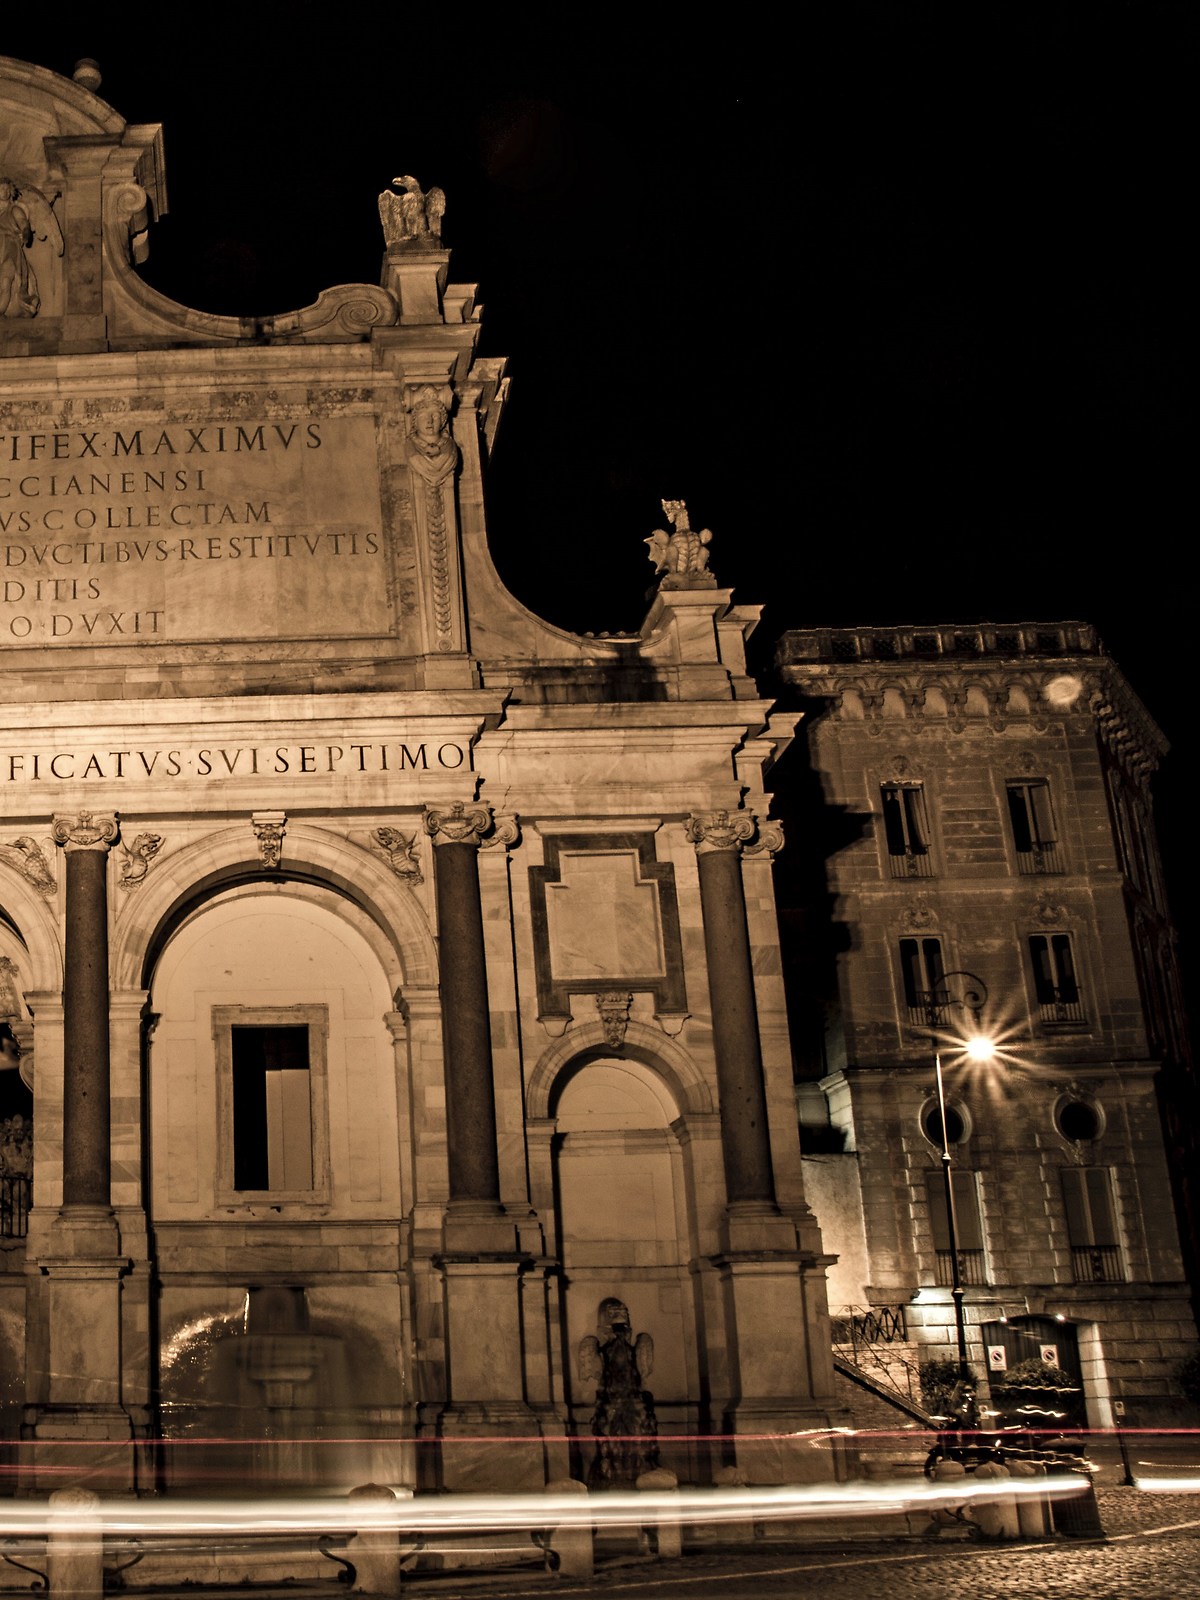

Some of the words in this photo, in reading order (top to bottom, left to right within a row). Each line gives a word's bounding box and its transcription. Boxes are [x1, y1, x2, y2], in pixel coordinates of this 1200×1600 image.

[112, 423, 323, 458] MAXIMVS
[42, 500, 273, 531] COLLECTAM
[4, 539, 168, 568] DVCTIBVS
[177, 531, 380, 560] RESTITVTIS
[51, 609, 166, 637] DVXIT
[197, 747, 260, 776] SVI
[273, 742, 464, 773] SEPTIMO
